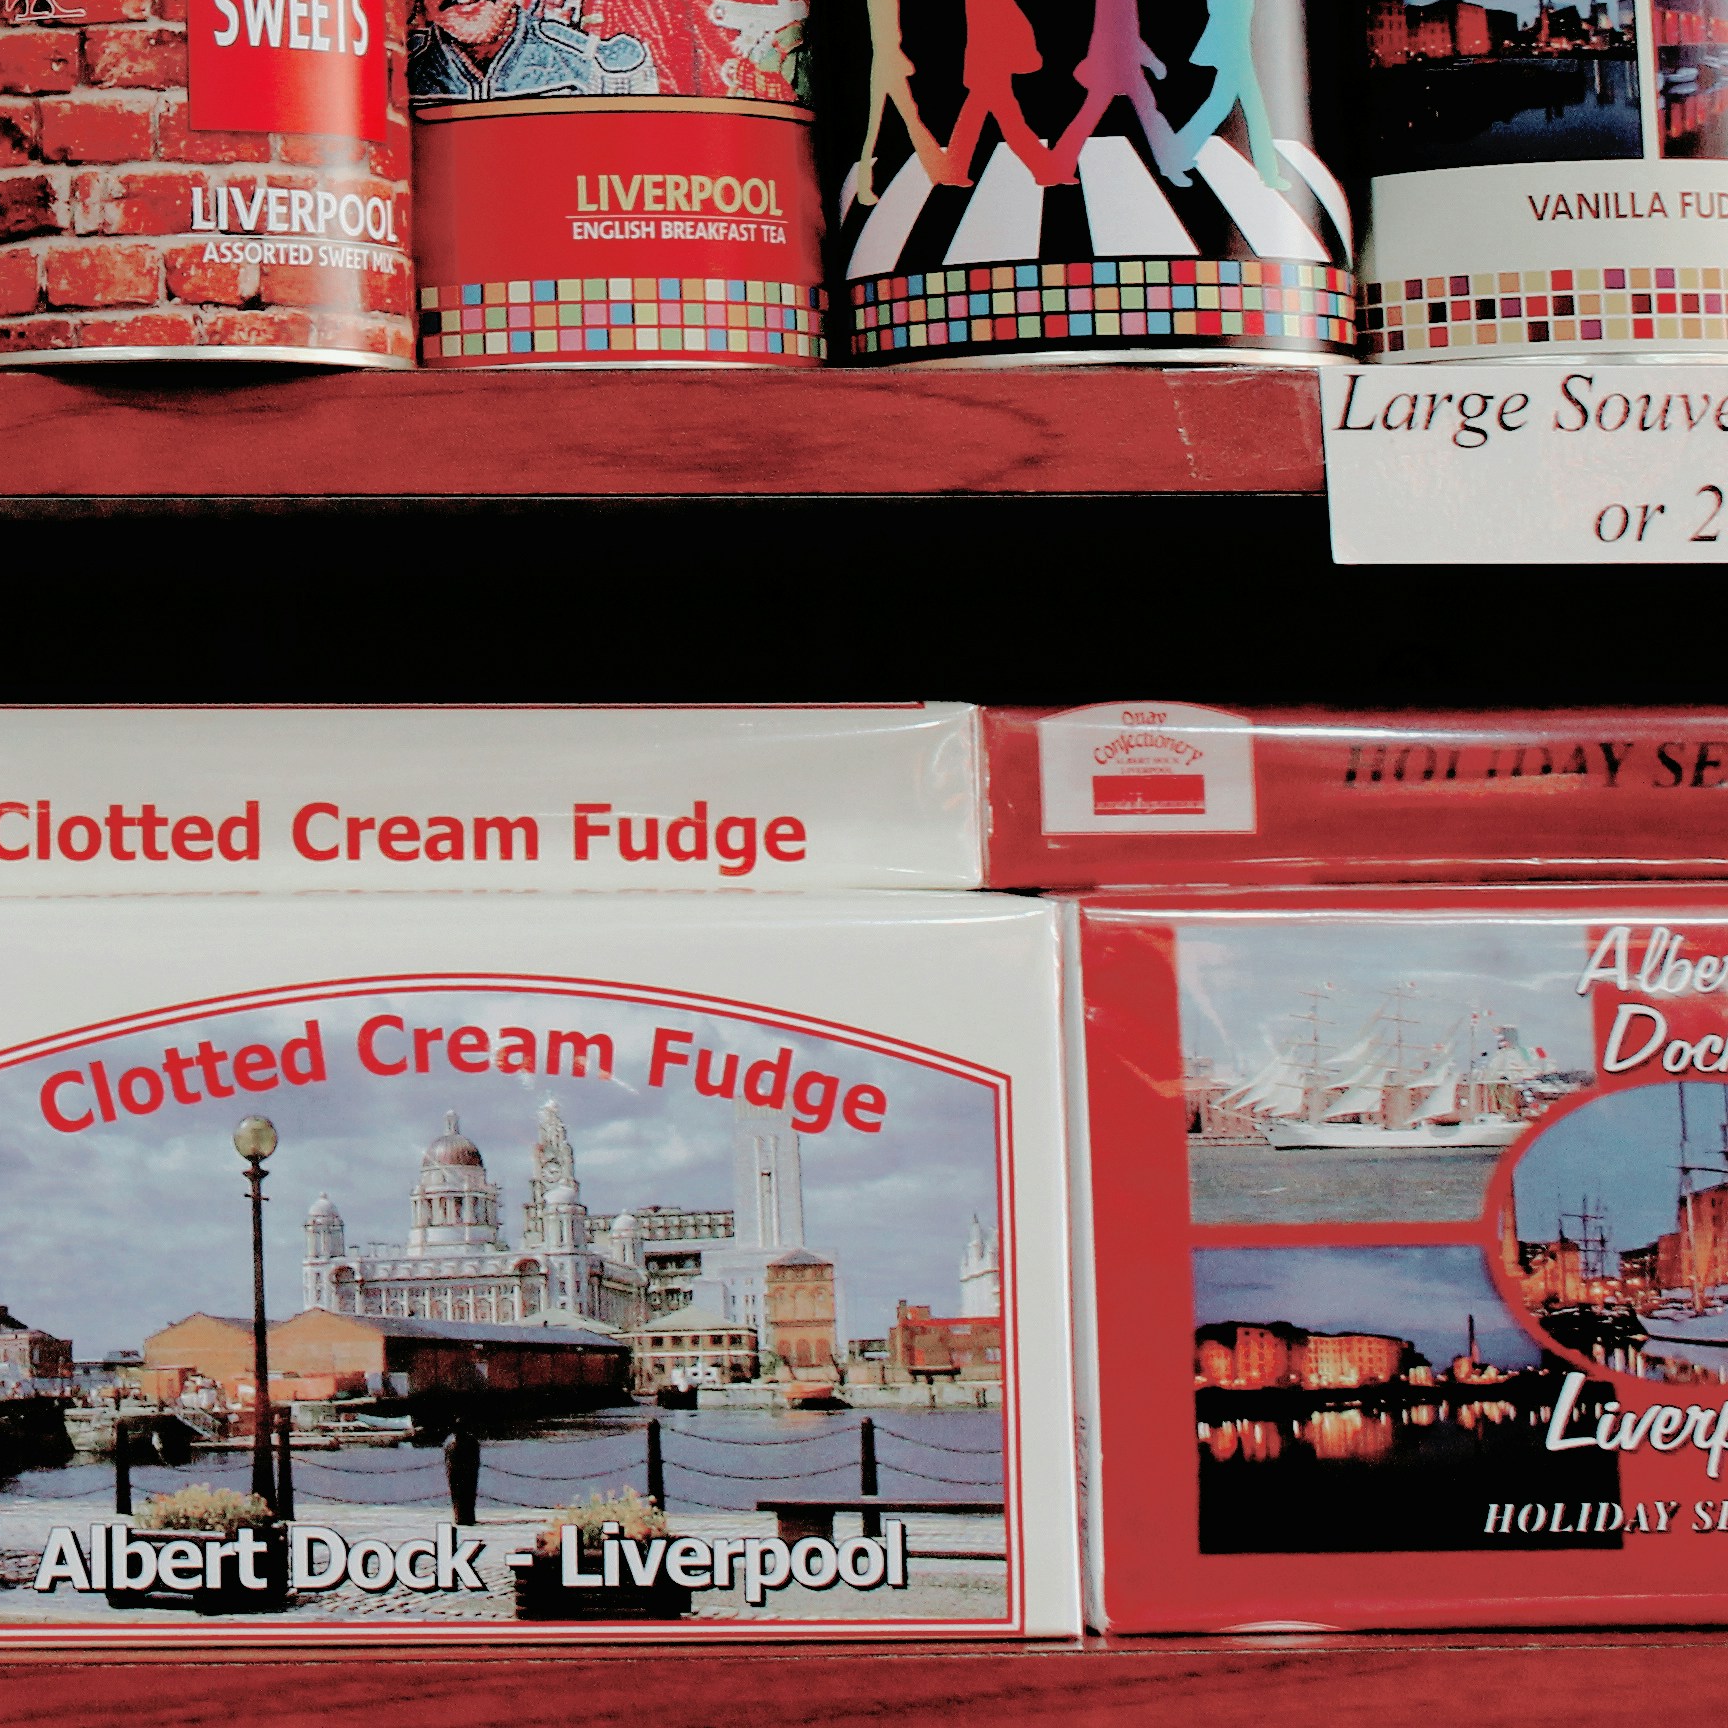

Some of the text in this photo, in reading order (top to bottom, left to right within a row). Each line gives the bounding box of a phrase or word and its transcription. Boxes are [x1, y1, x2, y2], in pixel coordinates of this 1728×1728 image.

[191, 186, 399, 243] LIVERPOOL
[577, 174, 783, 216] LIVERPOOL
[1528, 192, 1668, 221] VANILLA
[572, 221, 786, 244] ENGLISH BREAKFAST TEA
[202, 241, 396, 274] ASSORTED SWEET MIX
[1332, 374, 1529, 448] Large
[1595, 503, 1665, 543] or
[292, 801, 539, 864] Cream
[573, 803, 807, 877] Fudge
[39, 1013, 888, 1135] Clotted Cream Fudge
[1484, 1502, 1681, 1533] HOLIDAY
[34, 1519, 905, 1605] Albert Dock Liverpool
